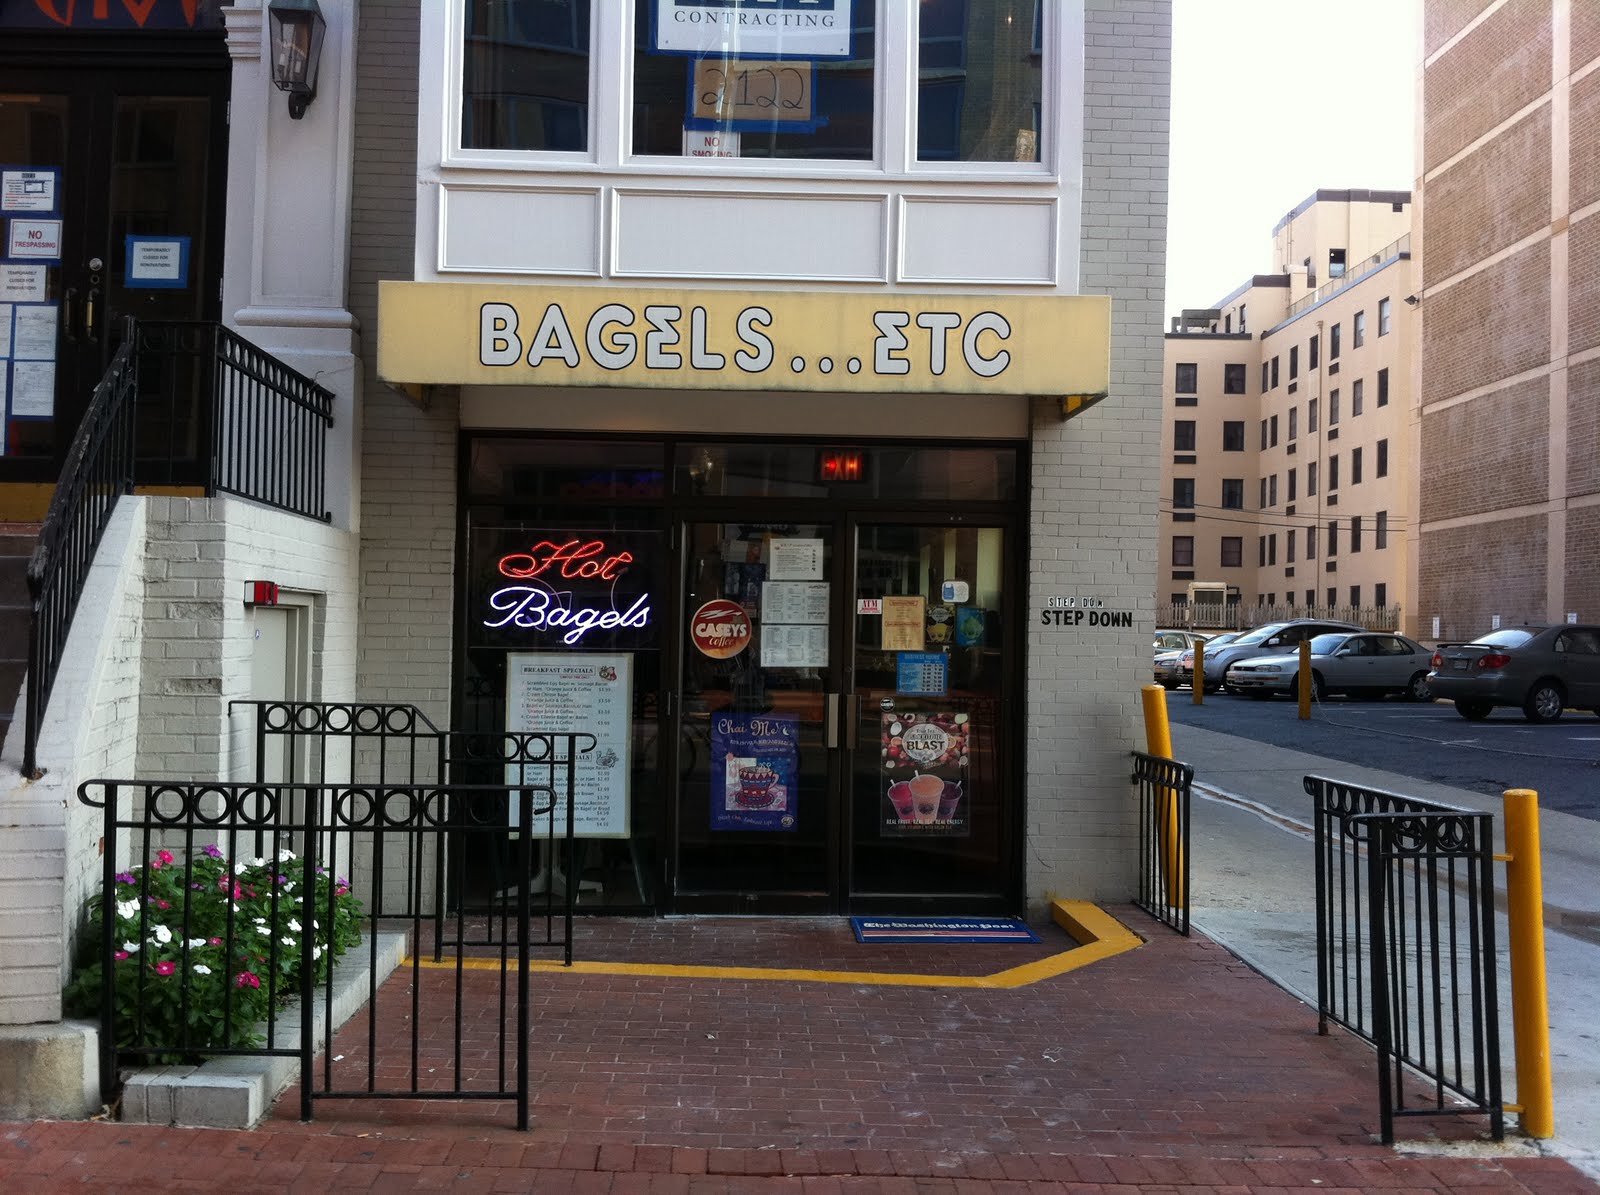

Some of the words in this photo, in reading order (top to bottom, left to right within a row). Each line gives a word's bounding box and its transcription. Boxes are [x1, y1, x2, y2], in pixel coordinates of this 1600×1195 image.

[674, 10, 835, 27] CONTRACTING
[701, 68, 804, 109] 2122
[704, 137, 720, 147] NO
[28, 230, 43, 240] NO
[15, 241, 56, 249] TRESPASSING
[499, 540, 633, 580] Hot
[863, 600, 878, 608] ATM
[1048, 597, 1075, 608] STEP
[484, 586, 650, 644] Bagels
[1041, 610, 1084, 626] STEP
[1089, 611, 1133, 627] DOWN
[695, 623, 747, 638] CASEYS
[718, 718, 746, 735] Chai
[906, 740, 945, 751] BLAST
[891, 922, 979, 930] Washington
